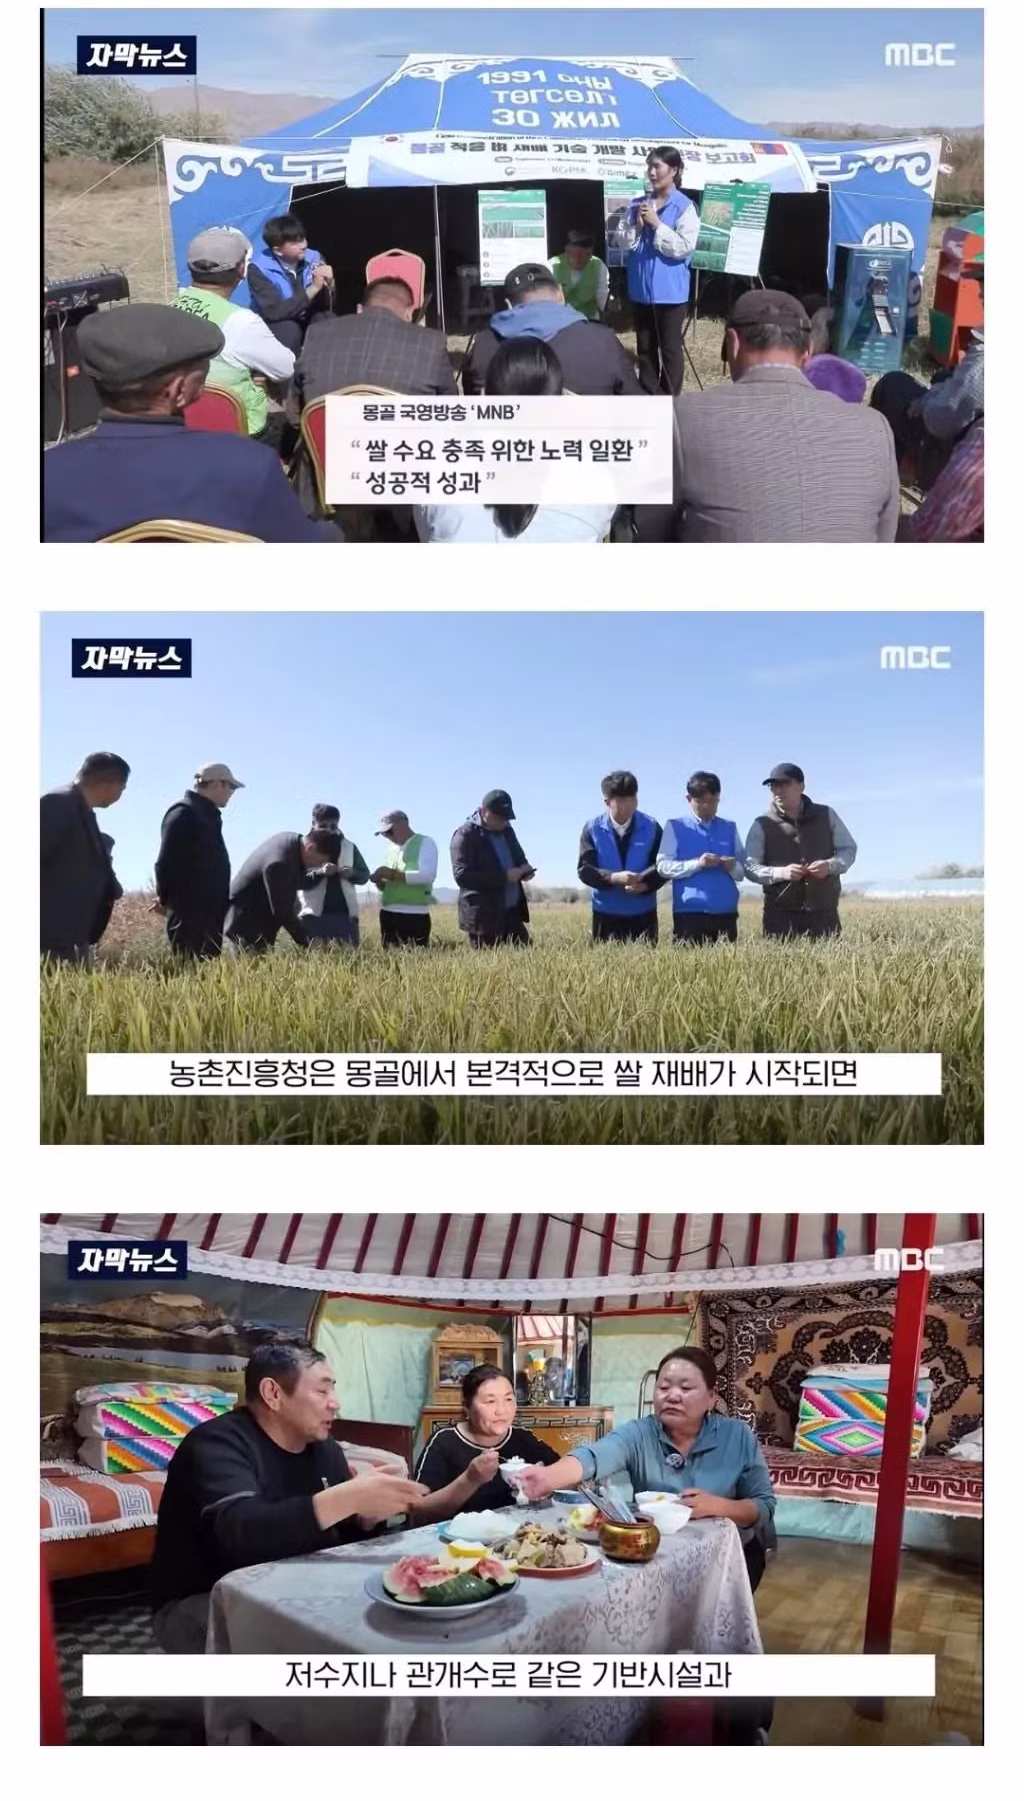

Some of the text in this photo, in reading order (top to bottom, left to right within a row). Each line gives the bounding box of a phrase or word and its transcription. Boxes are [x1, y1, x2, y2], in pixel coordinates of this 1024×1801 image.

[476, 70, 547, 85] 1991
[492, 108, 540, 127] 30
[705, 152, 757, 164] 보고회
